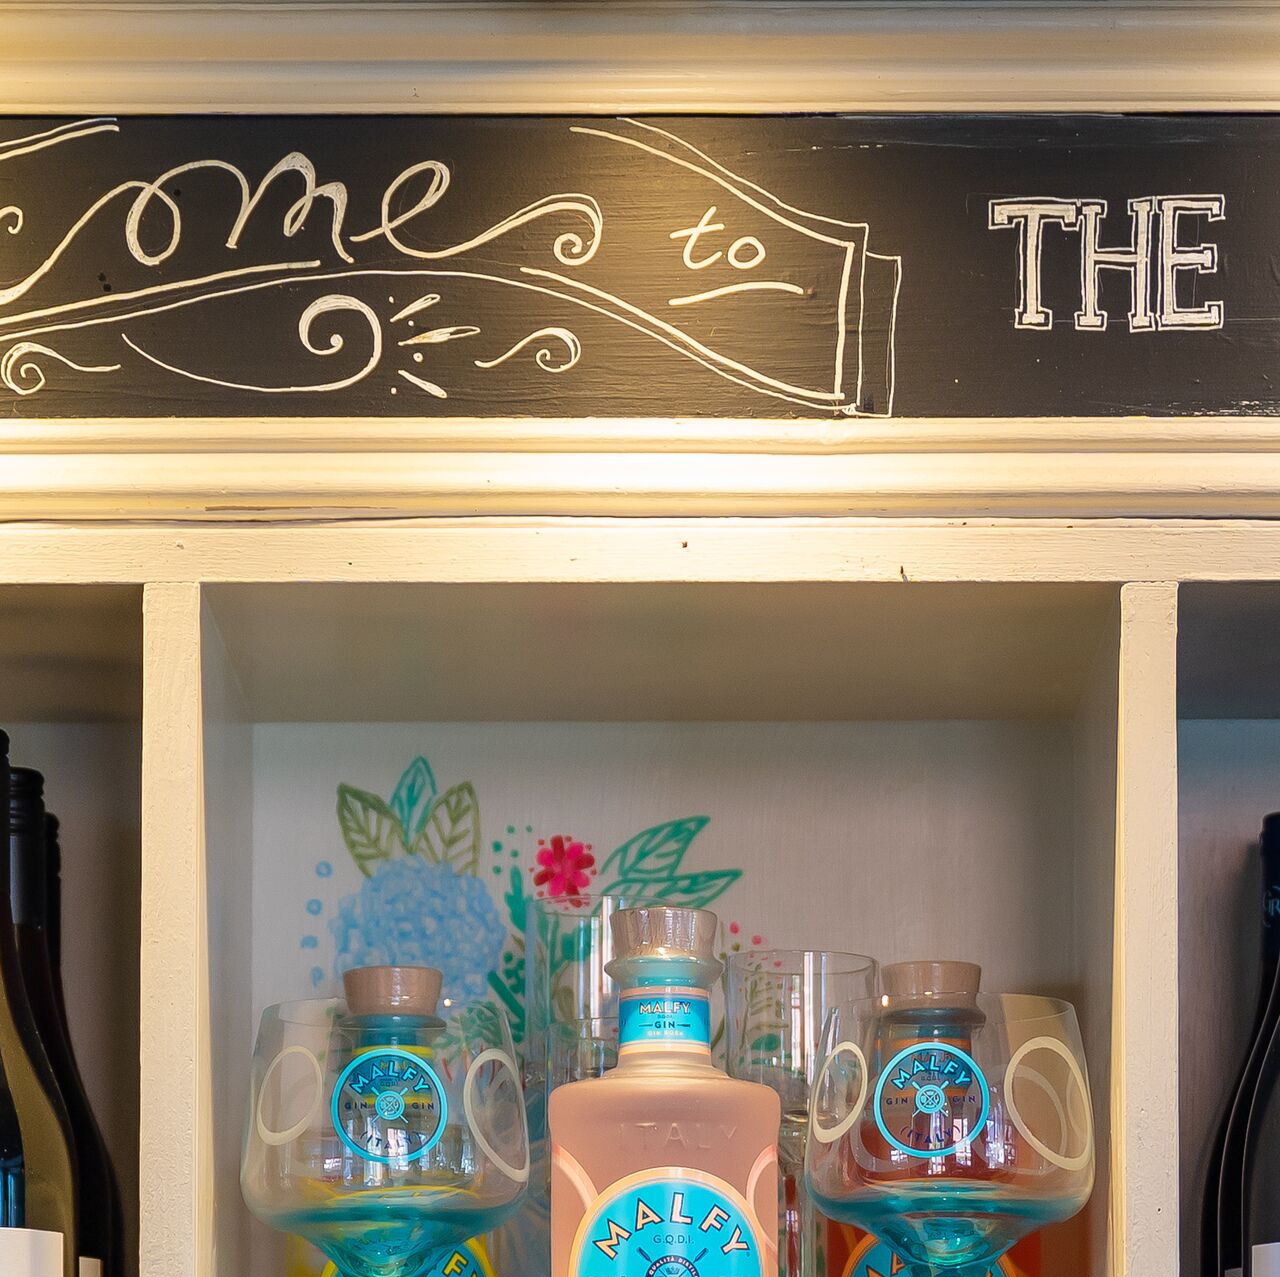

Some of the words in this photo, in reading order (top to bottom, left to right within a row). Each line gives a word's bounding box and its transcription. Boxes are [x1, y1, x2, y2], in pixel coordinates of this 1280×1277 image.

[671, 206, 767, 270] to
[989, 192, 1225, 333] THE
[639, 1001, 691, 1015] MALFY
[654, 1021, 676, 1029] GIN
[349, 1061, 430, 1094] MALFY
[891, 1055, 973, 1090] MALFY
[344, 1101, 368, 1110] GIN
[412, 1101, 435, 1110] GIN
[886, 1097, 908, 1105] GIN
[952, 1095, 976, 1104] GIN
[593, 1192, 750, 1260] MALFY
[653, 1234, 695, 1245] G.Q.D.I.
